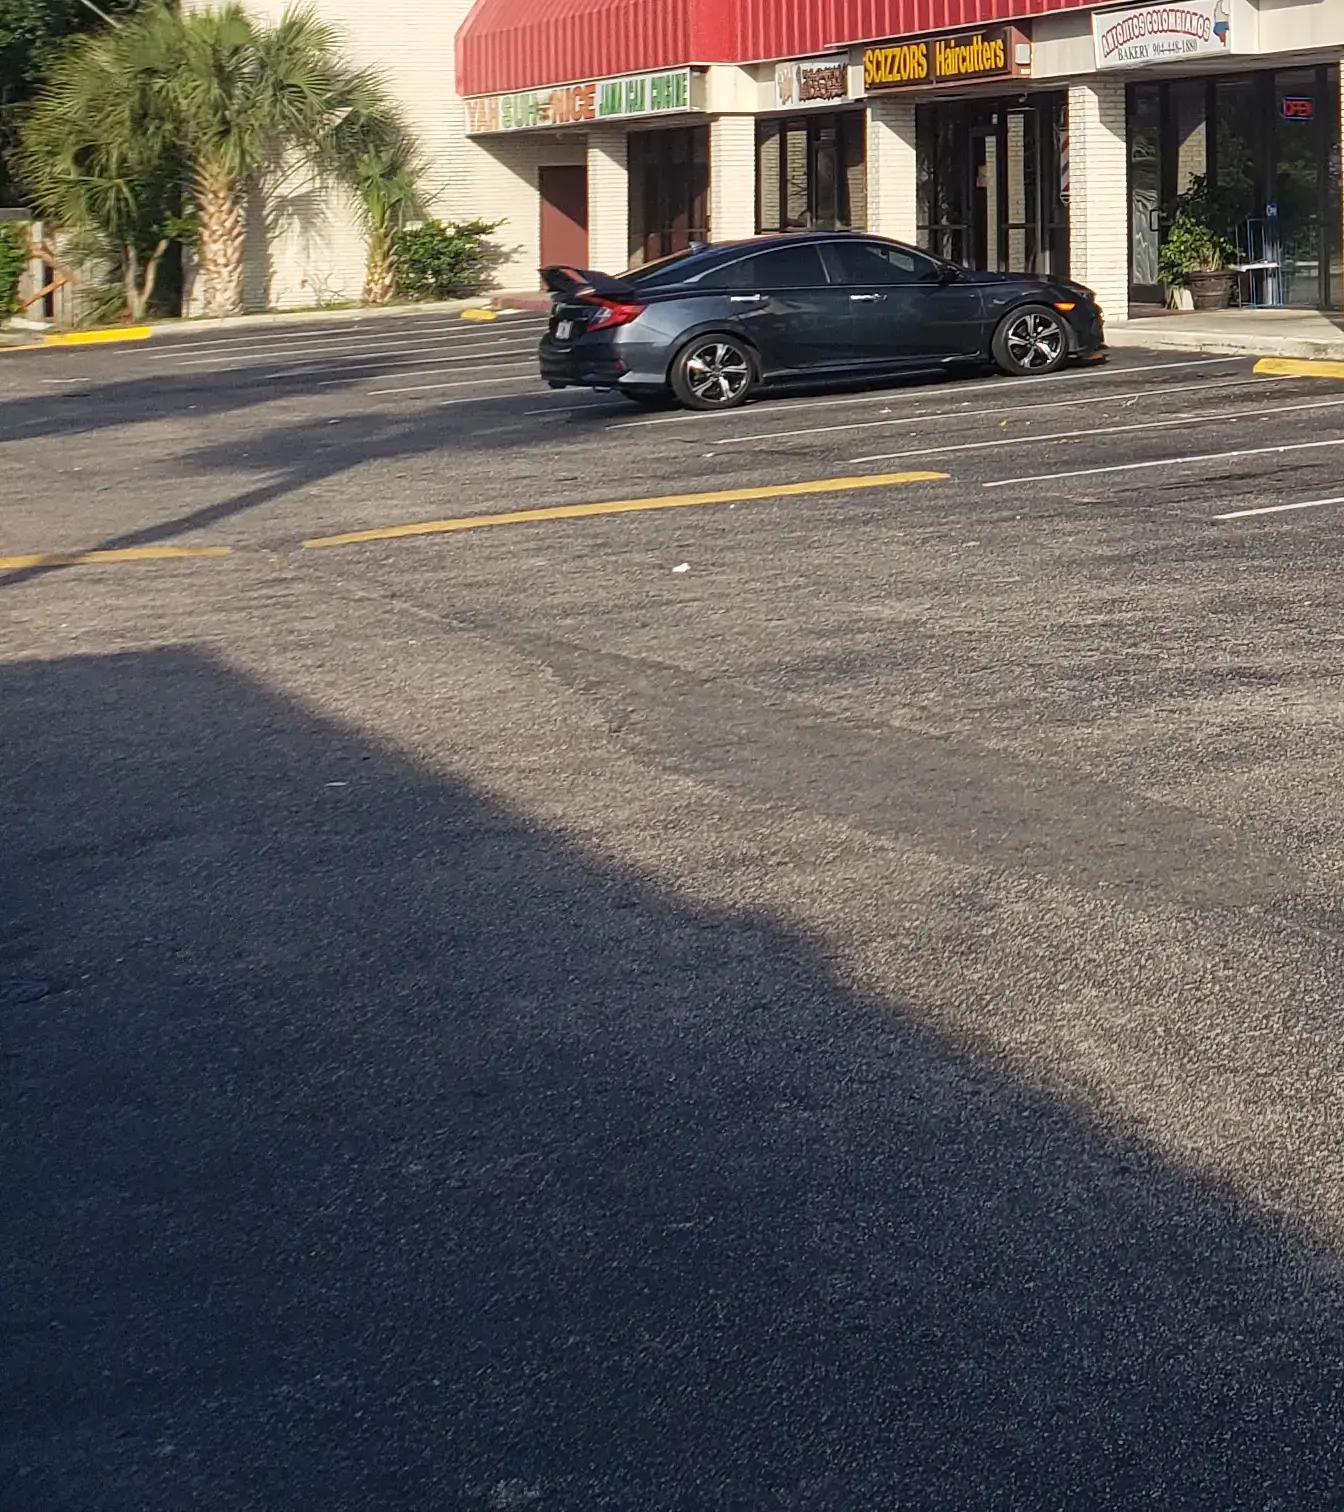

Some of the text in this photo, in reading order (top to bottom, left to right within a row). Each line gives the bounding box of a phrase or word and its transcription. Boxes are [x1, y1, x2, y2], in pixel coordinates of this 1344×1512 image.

[1145, 9, 1211, 42] COLOMBIANOS
[864, 43, 927, 83] SCIZZORS
[935, 35, 1004, 76] Haircutters
[1118, 44, 1150, 60] BAKERY
[466, 99, 499, 132] YAH
[551, 84, 596, 125] NICE
